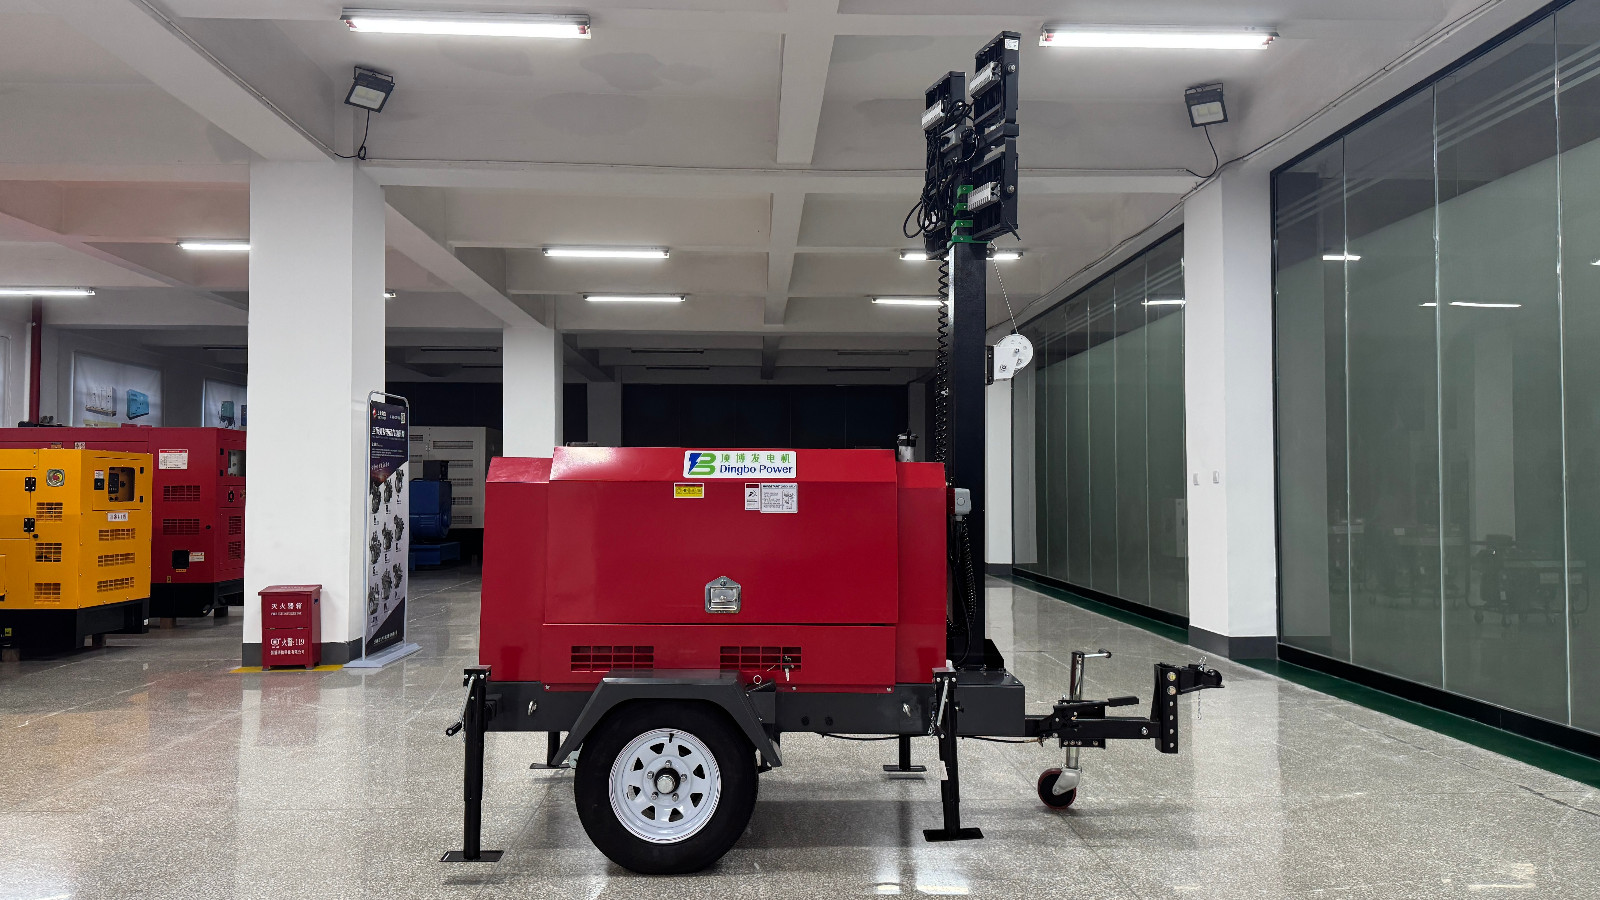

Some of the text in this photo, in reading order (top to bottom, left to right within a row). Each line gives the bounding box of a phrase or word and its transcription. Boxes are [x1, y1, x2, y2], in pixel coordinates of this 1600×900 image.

[720, 452, 791, 464] 顶博发电机
[719, 464, 794, 476] Dingbo Power
